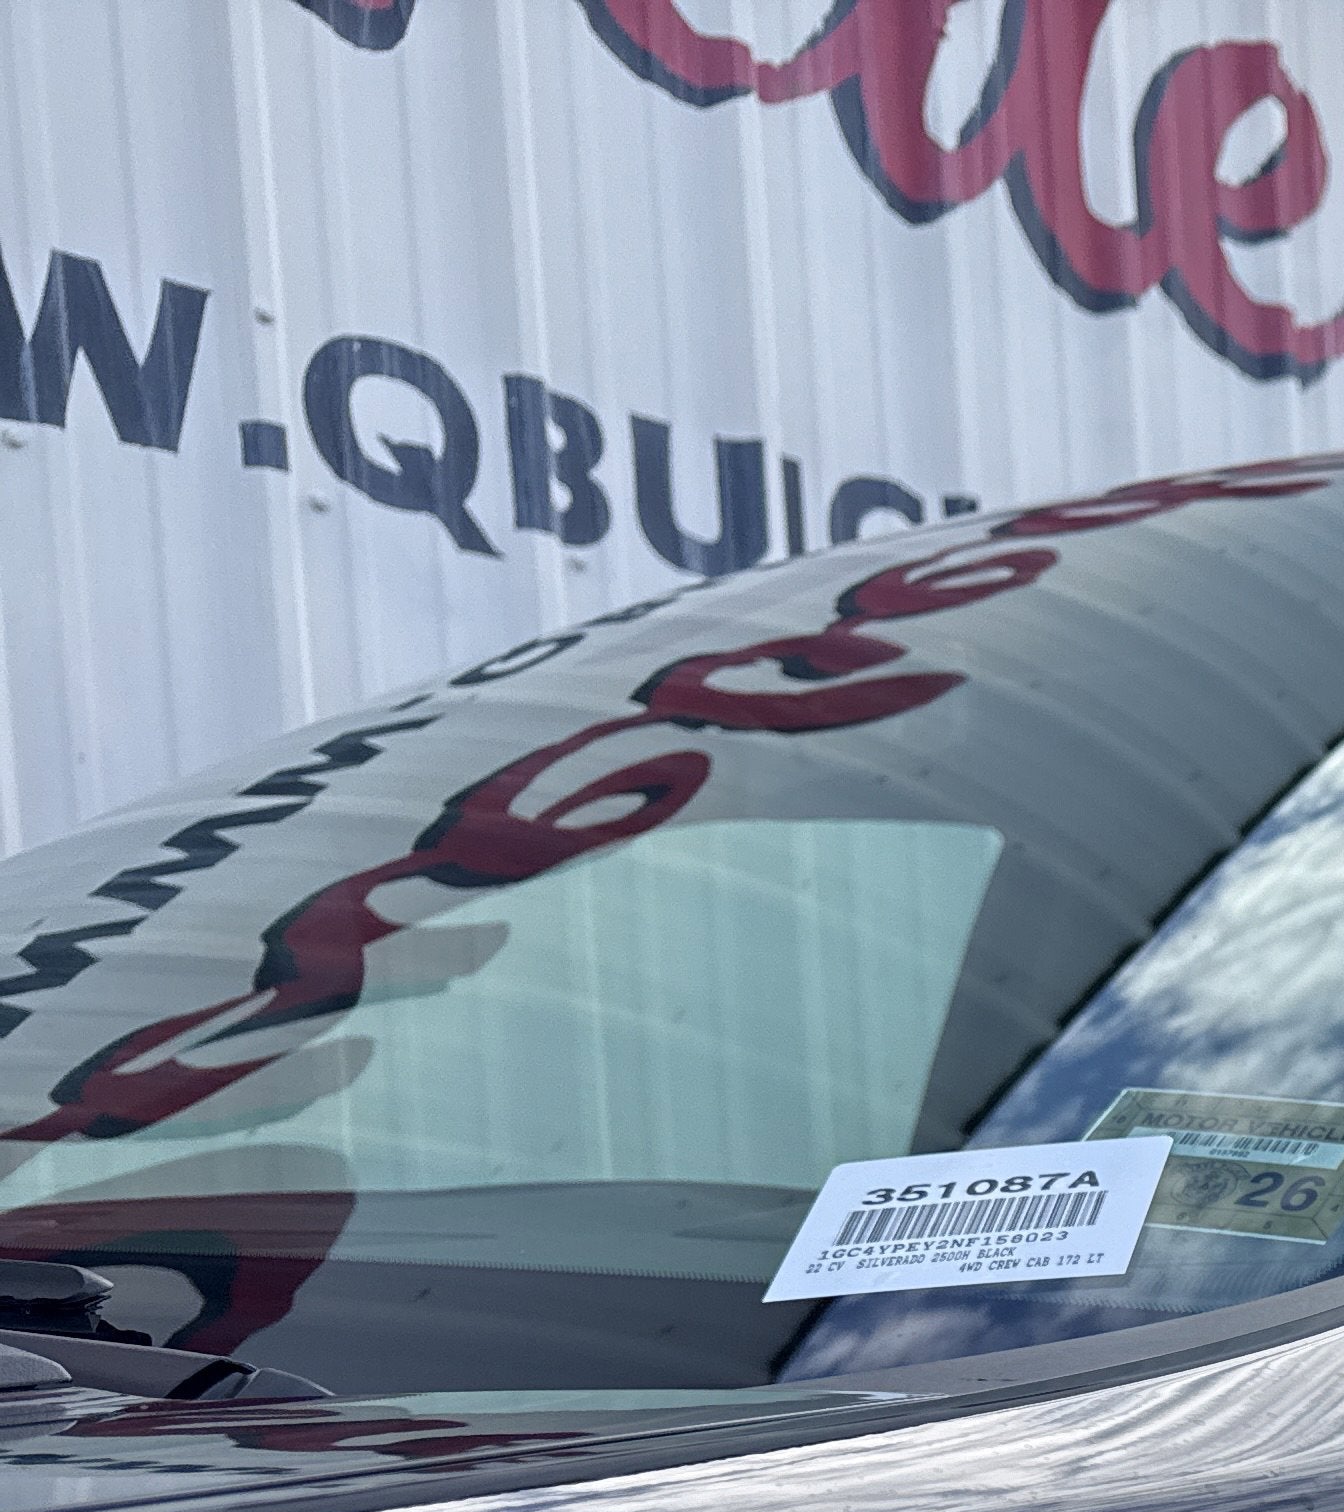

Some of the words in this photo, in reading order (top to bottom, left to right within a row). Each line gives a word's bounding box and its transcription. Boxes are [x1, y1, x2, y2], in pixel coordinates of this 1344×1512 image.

[0, 240, 980, 578] W.QBUI
[1142, 1112, 1239, 1132] MOTOR
[862, 1170, 1101, 1206] 351087A
[1234, 1171, 1326, 1212] 26
[805, 1263, 822, 1274] 22
[856, 1254, 926, 1270] SILVERADO
[977, 1247, 1016, 1259] BLACK
[959, 1261, 983, 1273] 4WD
[988, 1259, 1020, 1271] CREW
[1026, 1256, 1050, 1268] CAB
[1057, 1254, 1081, 1266] 172
[1087, 1252, 1104, 1264] LT
